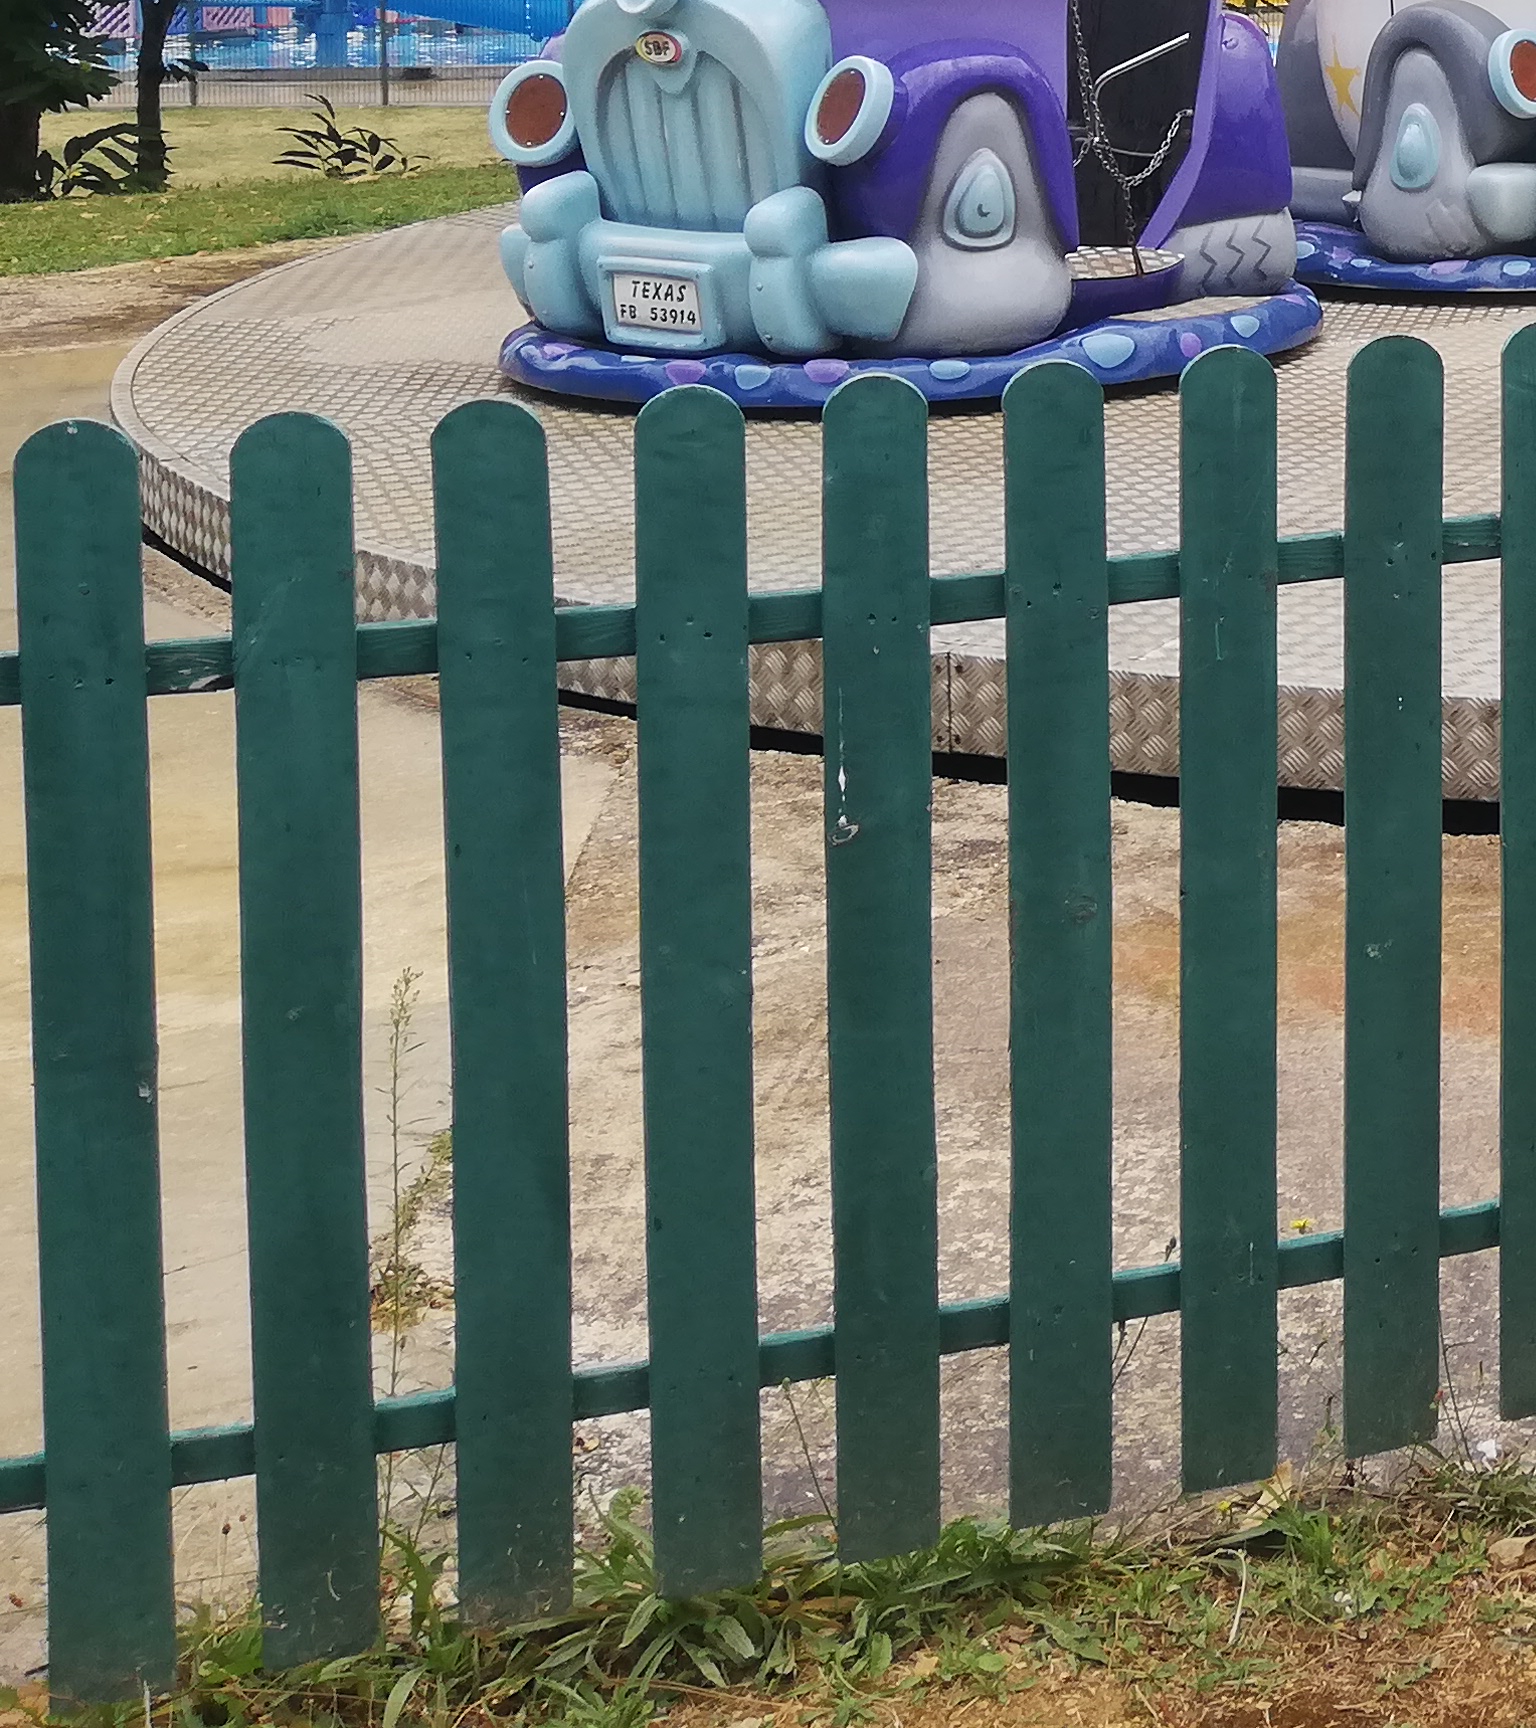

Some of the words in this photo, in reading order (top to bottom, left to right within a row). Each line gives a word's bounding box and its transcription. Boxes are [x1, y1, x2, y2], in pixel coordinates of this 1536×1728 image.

[643, 40, 670, 56] SBF
[631, 280, 687, 303] TEXAS
[620, 304, 637, 319] FB
[650, 307, 697, 325] 53914
